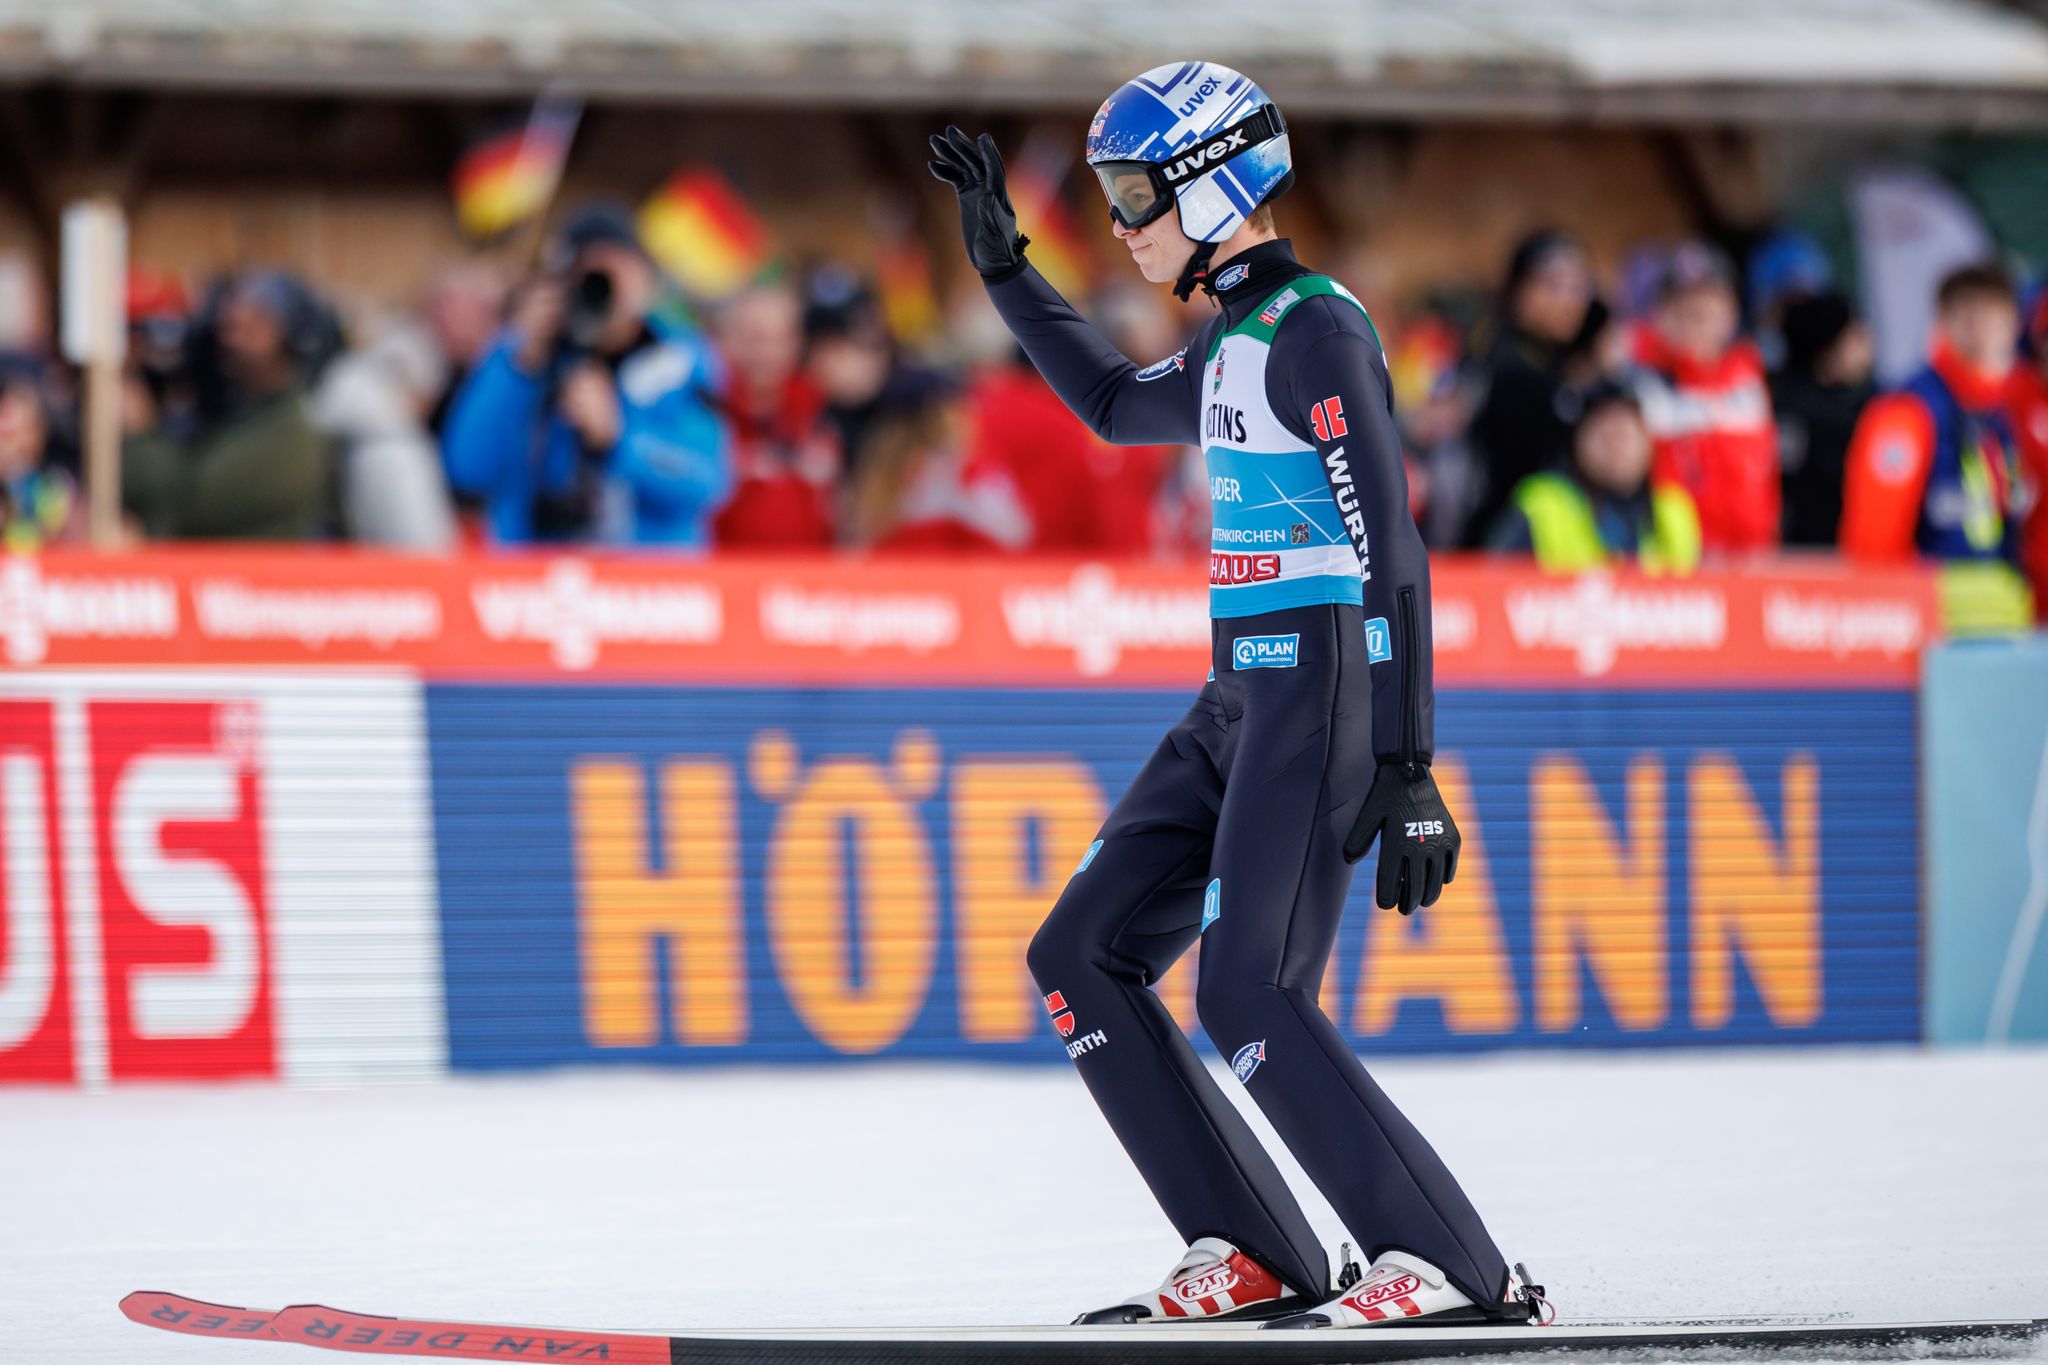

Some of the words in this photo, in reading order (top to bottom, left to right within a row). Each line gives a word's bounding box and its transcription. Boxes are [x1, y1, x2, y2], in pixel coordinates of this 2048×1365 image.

[1178, 76, 1222, 118] uvex
[1162, 128, 1248, 181] uvex
[1325, 446, 1371, 583] WÜRTH
[1258, 641, 1294, 656] PLAN
[1405, 820, 1444, 842] SEIZ
[1065, 1029, 1108, 1060] ÜRTH
[151, 1304, 277, 1334] EER
[303, 1318, 469, 1349] DEER
[490, 1335, 609, 1359] VAN
